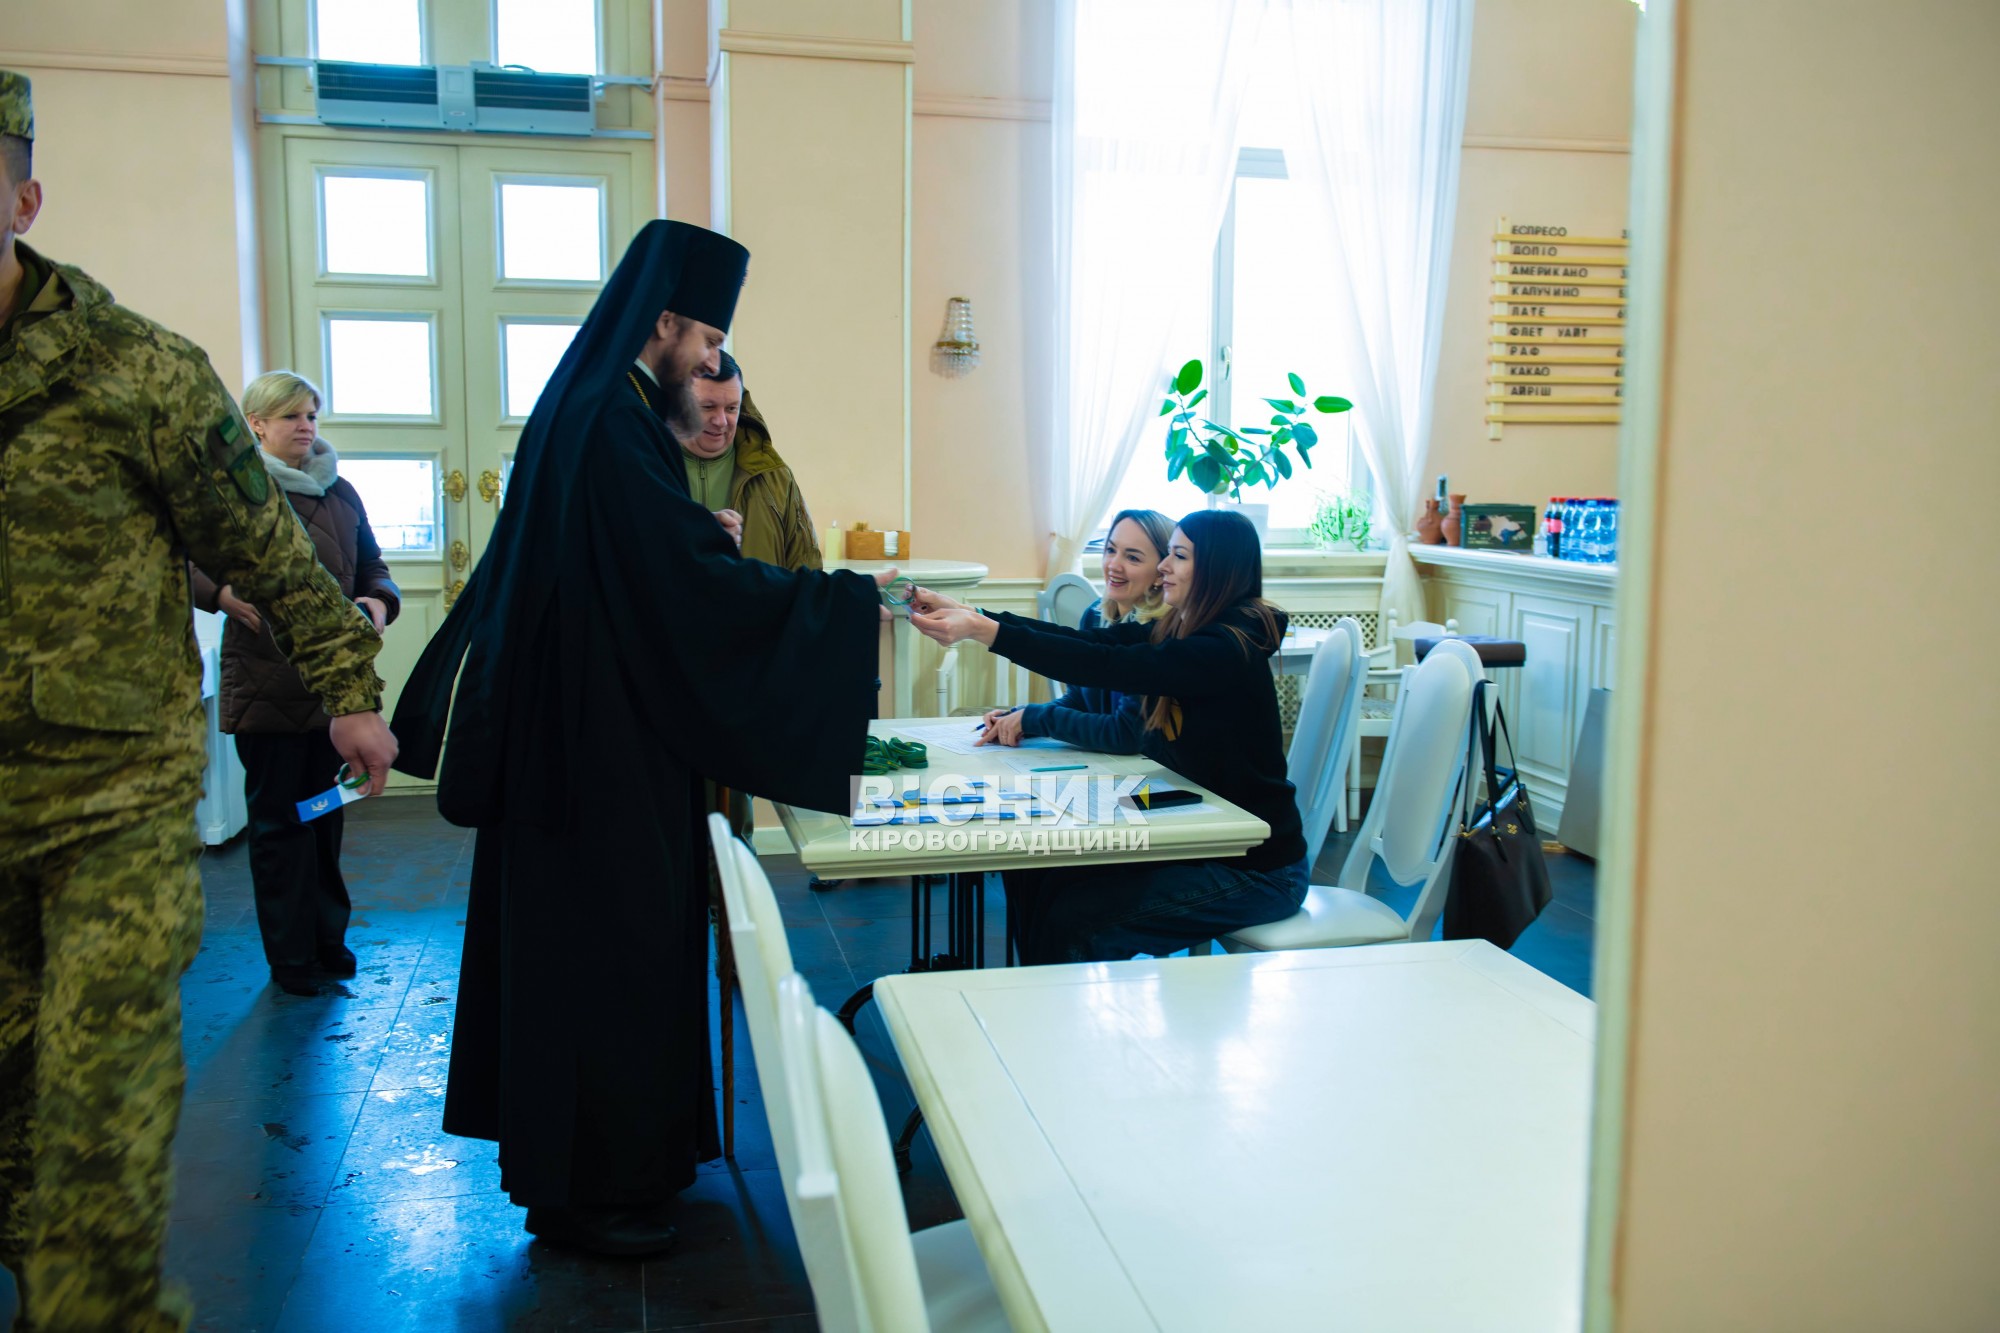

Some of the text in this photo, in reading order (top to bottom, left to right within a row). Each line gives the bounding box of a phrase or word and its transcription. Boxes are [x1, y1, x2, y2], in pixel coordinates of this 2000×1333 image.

[1512, 225, 1567, 236] ЕСПРЕСО
[1513, 245, 1557, 256] ДОПІО
[1512, 266, 1588, 277] АМЕРИКАНО
[1512, 286, 1579, 297] КАПУЧИНО
[1512, 307, 1545, 316] ЛАТЕ
[1510, 327, 1588, 337] ФЛЕТ УАЙТ
[1510, 346, 1539, 355] РАФ
[1510, 366, 1550, 376] КАКАО
[1511, 386, 1551, 396] АЙРІШ
